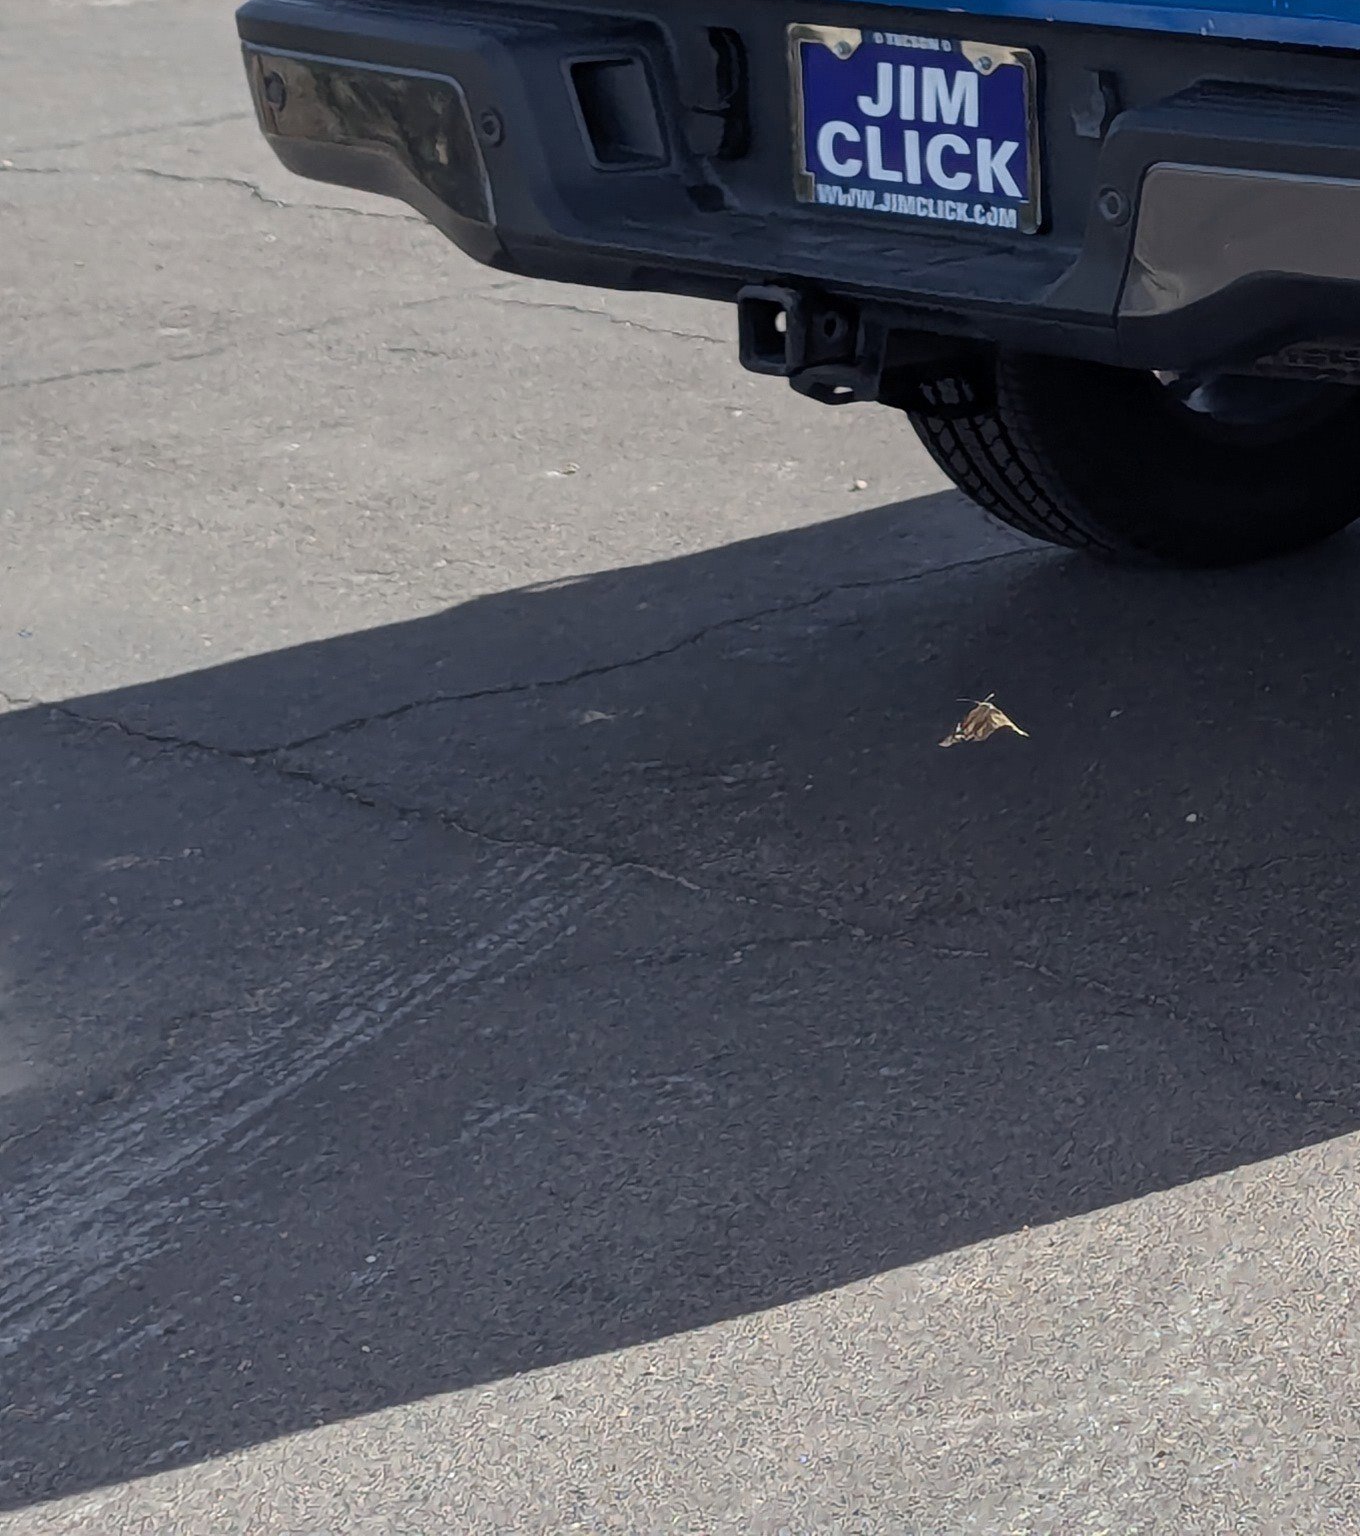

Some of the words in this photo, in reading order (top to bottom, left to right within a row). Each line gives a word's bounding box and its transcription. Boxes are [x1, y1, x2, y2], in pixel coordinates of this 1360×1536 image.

[856, 61, 980, 128] JIM
[815, 120, 1023, 199] CLICK
[815, 183, 1018, 229] WWW.JIMCLICK.COM
